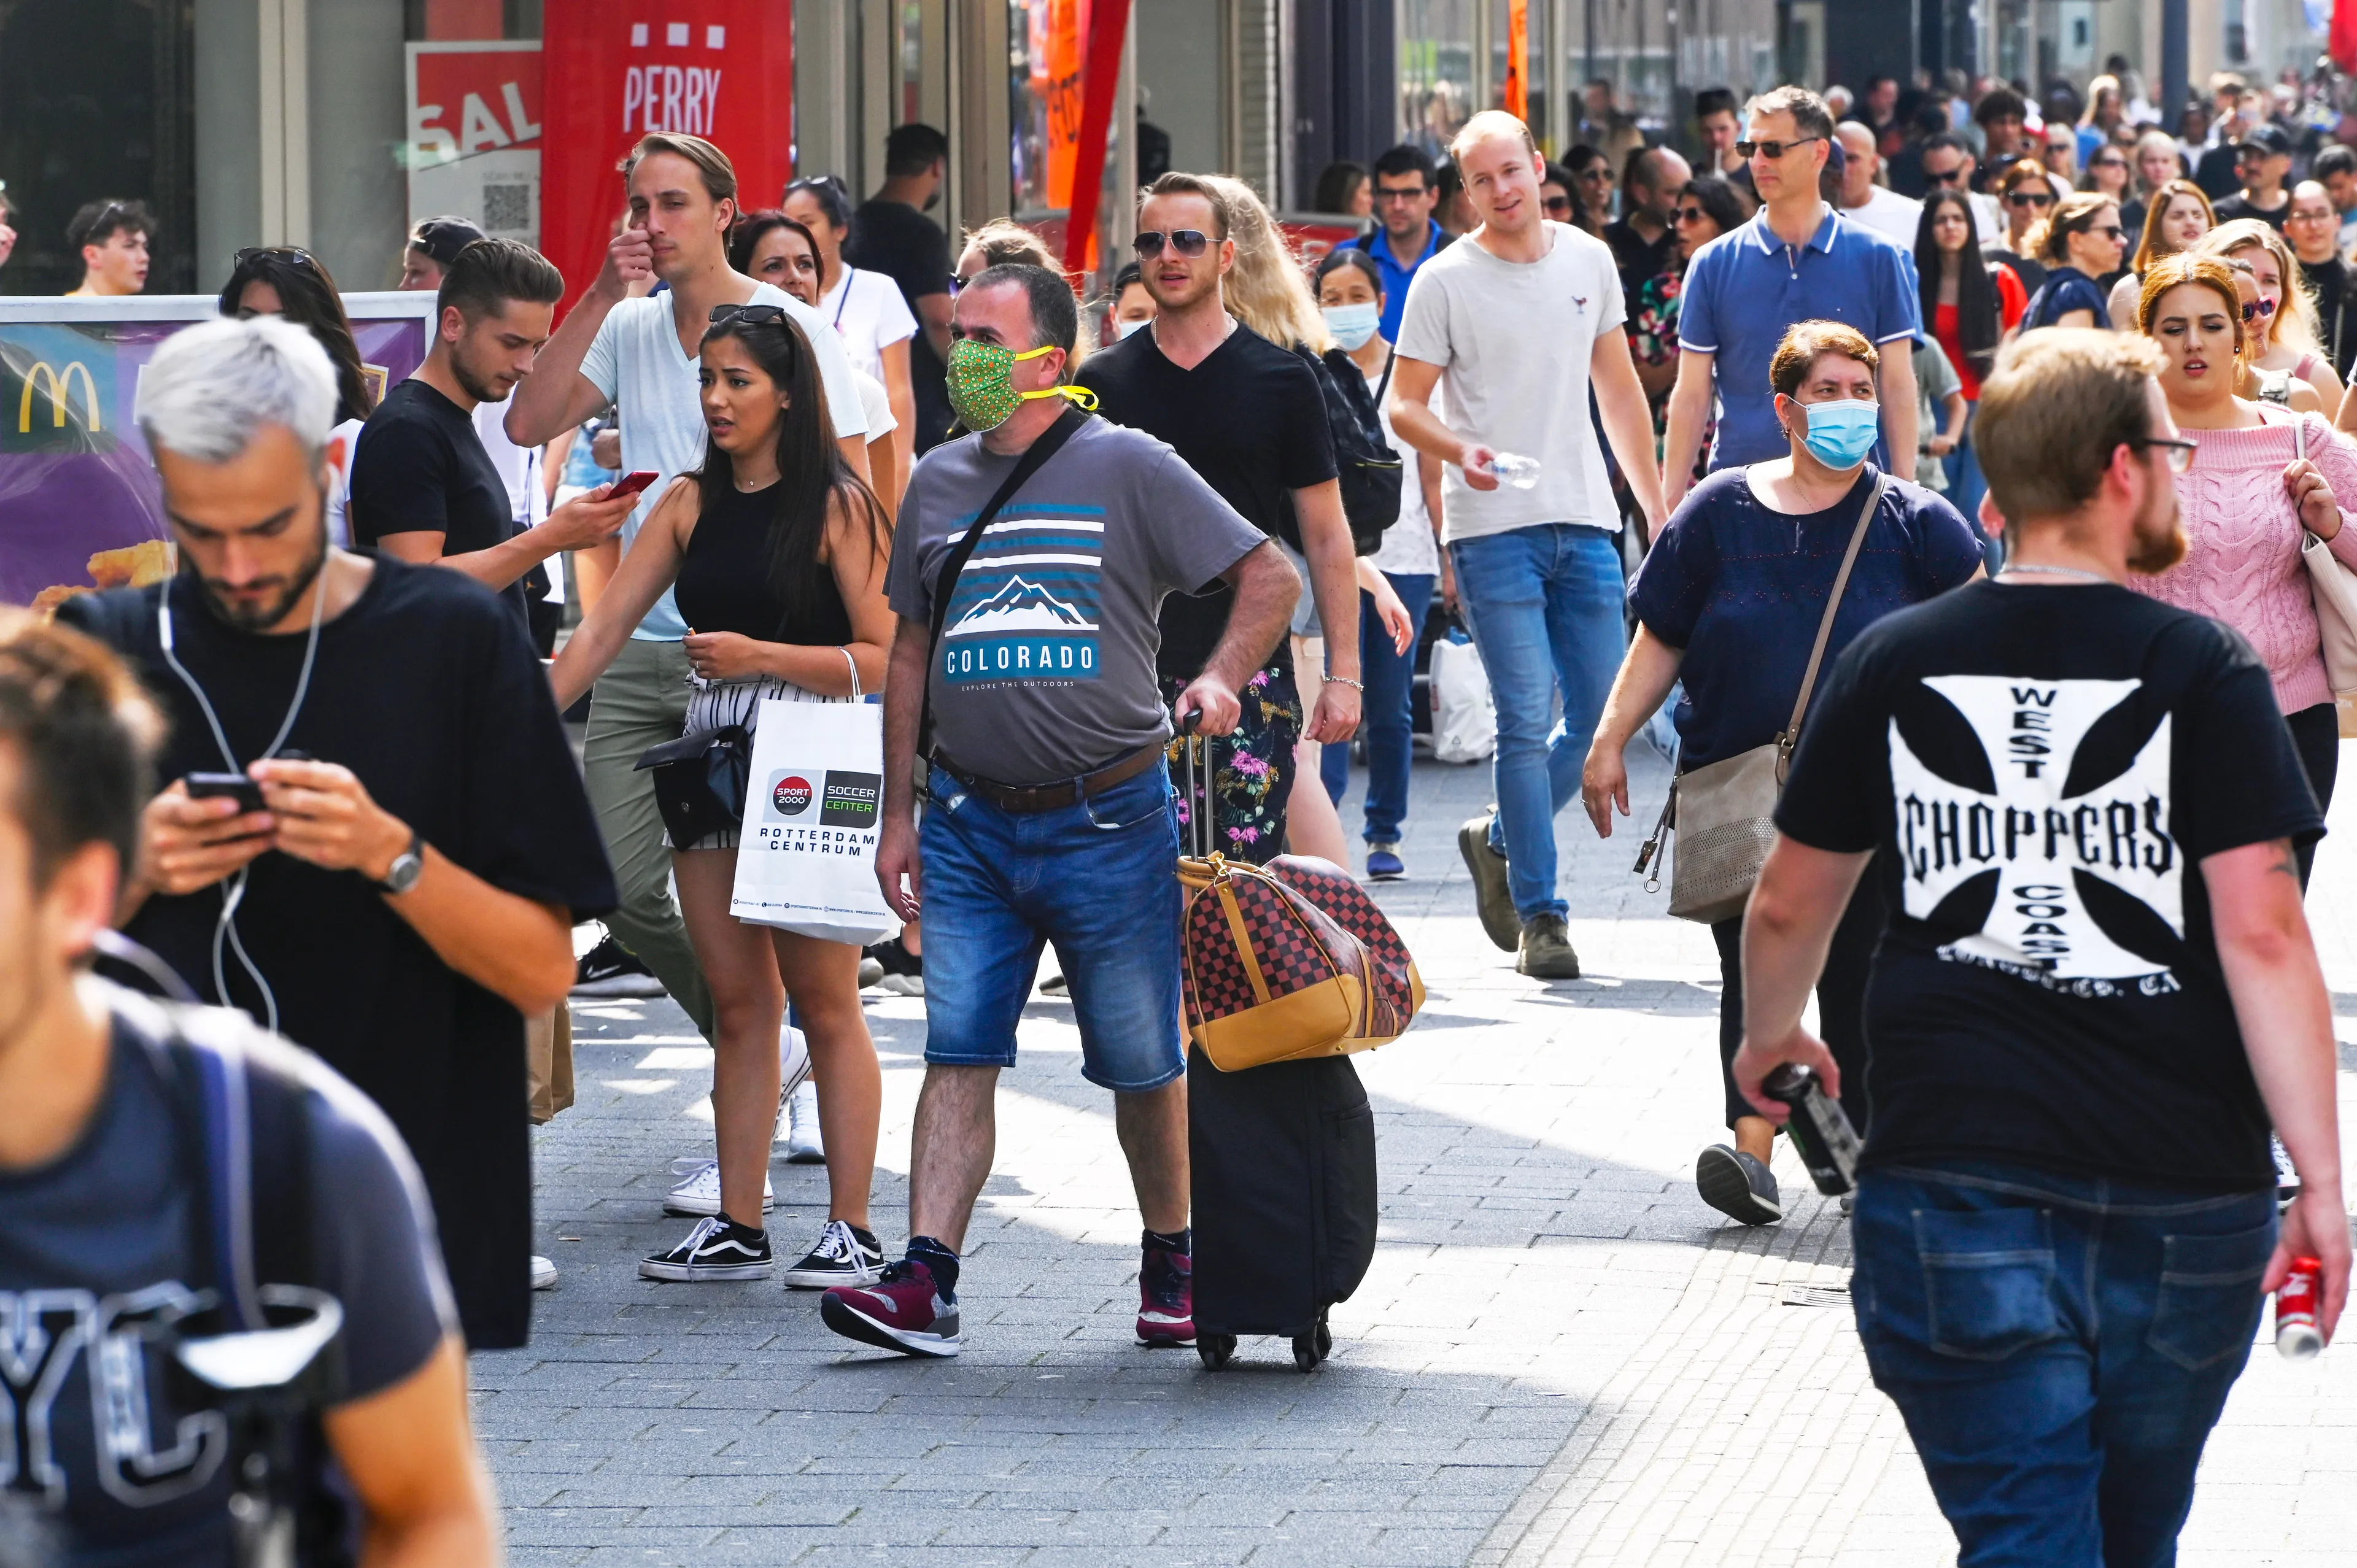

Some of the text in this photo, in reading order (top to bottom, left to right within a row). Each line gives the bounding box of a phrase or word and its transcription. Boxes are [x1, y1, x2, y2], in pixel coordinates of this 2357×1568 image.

[622, 65, 722, 136] PERRY
[947, 646, 1093, 674] COLORADO
[2010, 687, 2057, 778] WEST
[827, 786, 875, 798] SOCCER
[826, 800, 873, 813] CENTER
[760, 828, 875, 845] ROTTERDAM
[1904, 788, 2173, 884] CHOPPERS
[770, 840, 861, 856] CENTRUM
